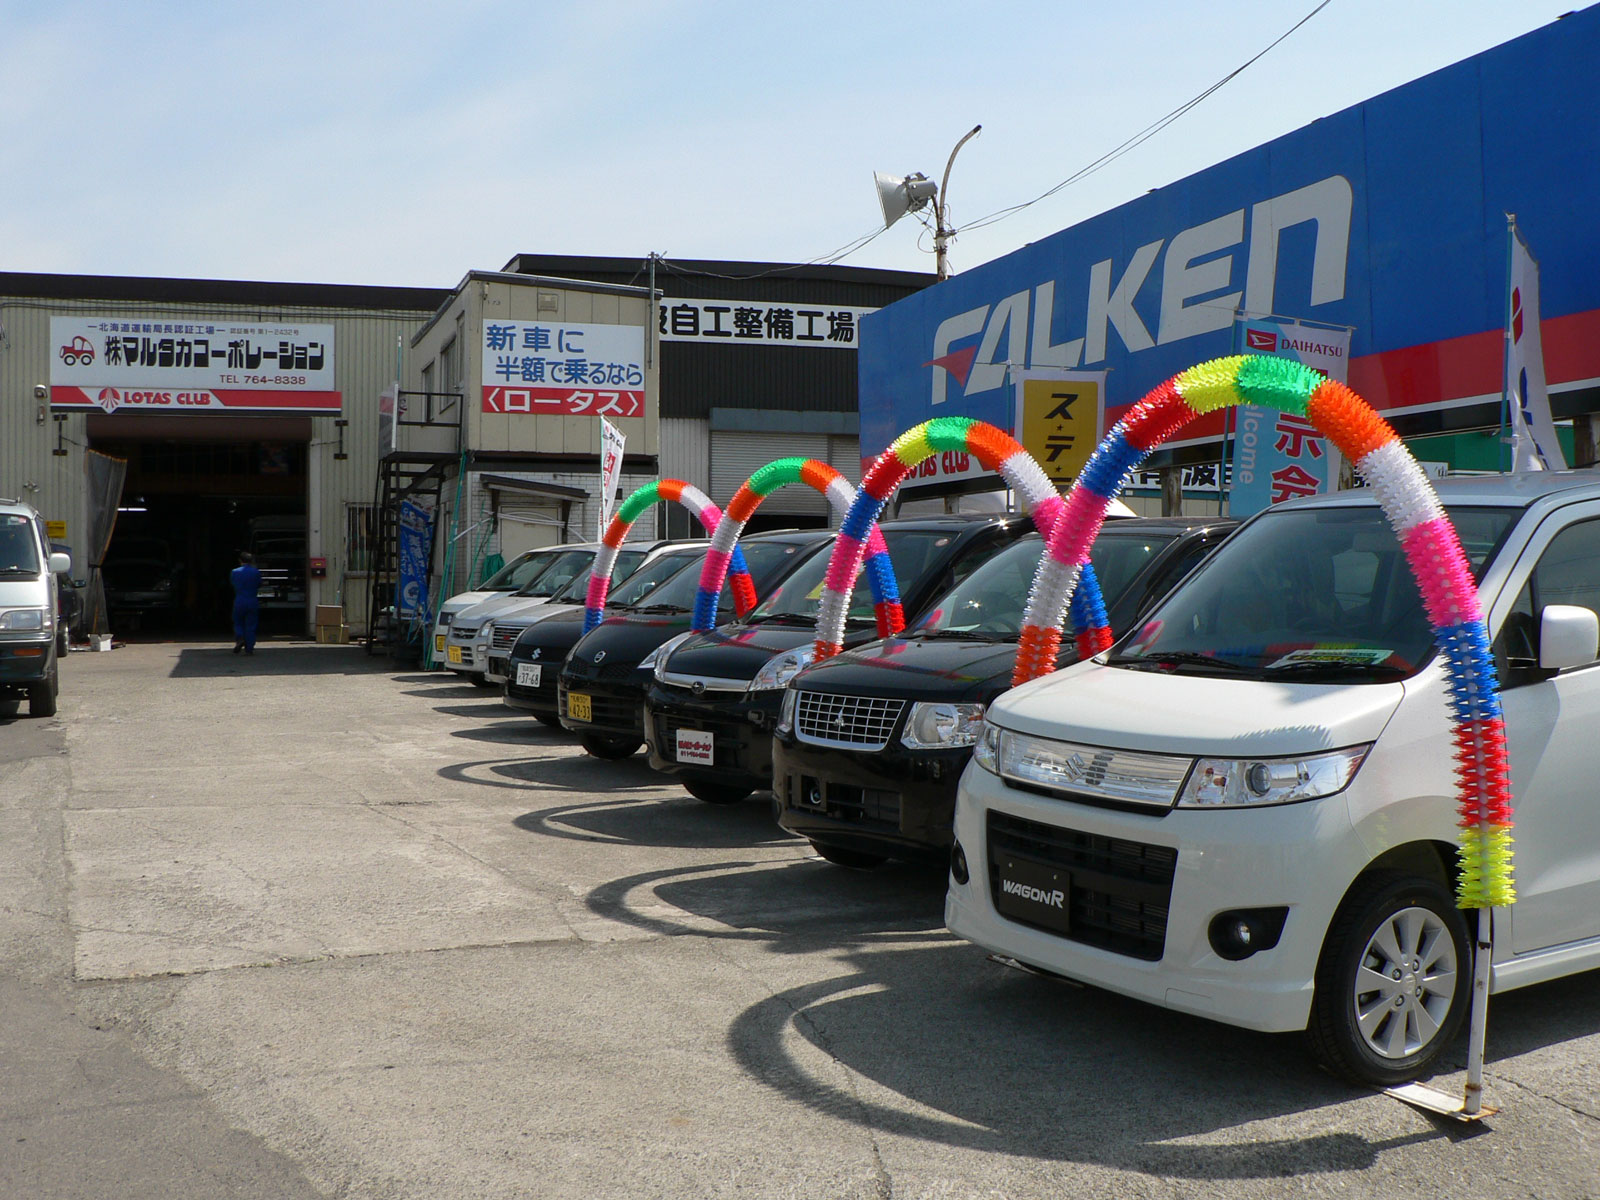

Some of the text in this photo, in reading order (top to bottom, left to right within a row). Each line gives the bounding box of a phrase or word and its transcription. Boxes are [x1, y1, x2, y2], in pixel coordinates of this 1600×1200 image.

[931, 175, 1353, 405] FALKEN
[486, 324, 585, 353] 新車に
[1281, 338, 1343, 358] DAIHATSU
[220, 375, 306, 385] TEL 764-8338
[495, 355, 643, 386] 半額で乗るなら
[124, 391, 211, 405] LOTAS CLUB
[941, 449, 970, 475] CLUB
